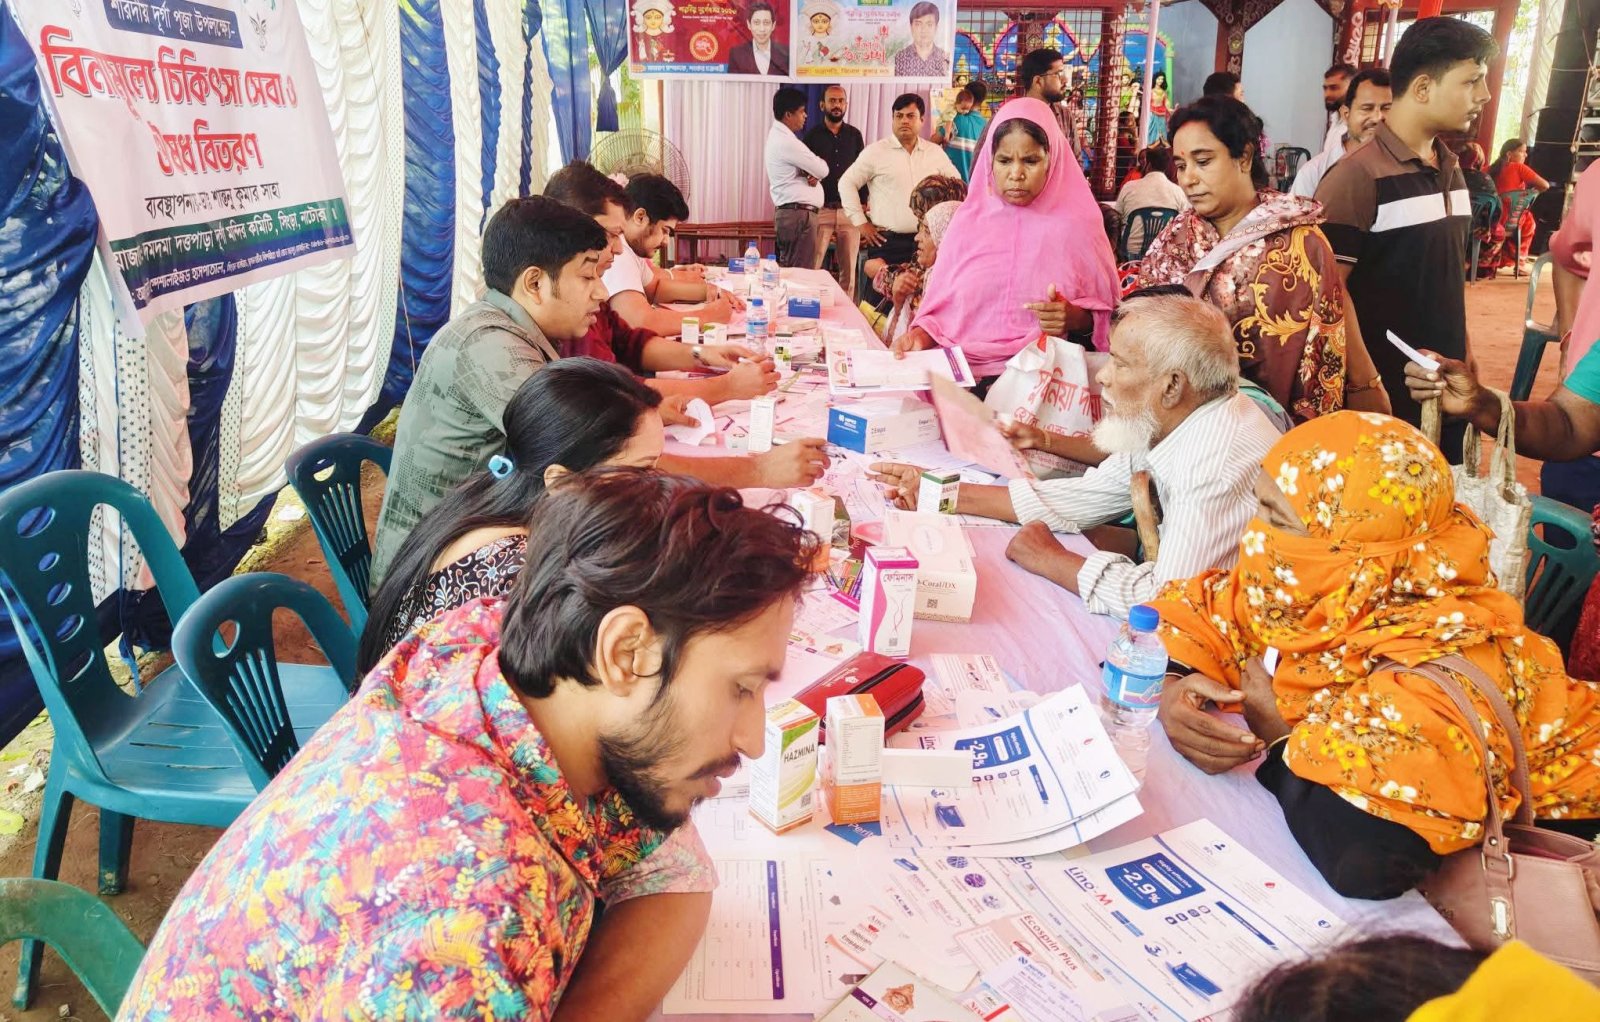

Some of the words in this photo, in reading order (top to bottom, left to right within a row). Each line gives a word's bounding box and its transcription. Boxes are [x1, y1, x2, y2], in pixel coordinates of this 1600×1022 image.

[173, 9, 194, 38] পূজা
[157, 44, 243, 108] চিকিৎসা
[244, 70, 286, 108] সেবা
[285, 79, 299, 108] ও
[146, 120, 197, 176] ঔষধ
[193, 118, 264, 176] বিতরণ
[234, 184, 260, 210] কুমার
[260, 182, 281, 201] সাহা
[783, 742, 816, 764] HAZMINA
[1022, 914, 1061, 953] Ecosprin
[1060, 949, 1079, 972] Plus
